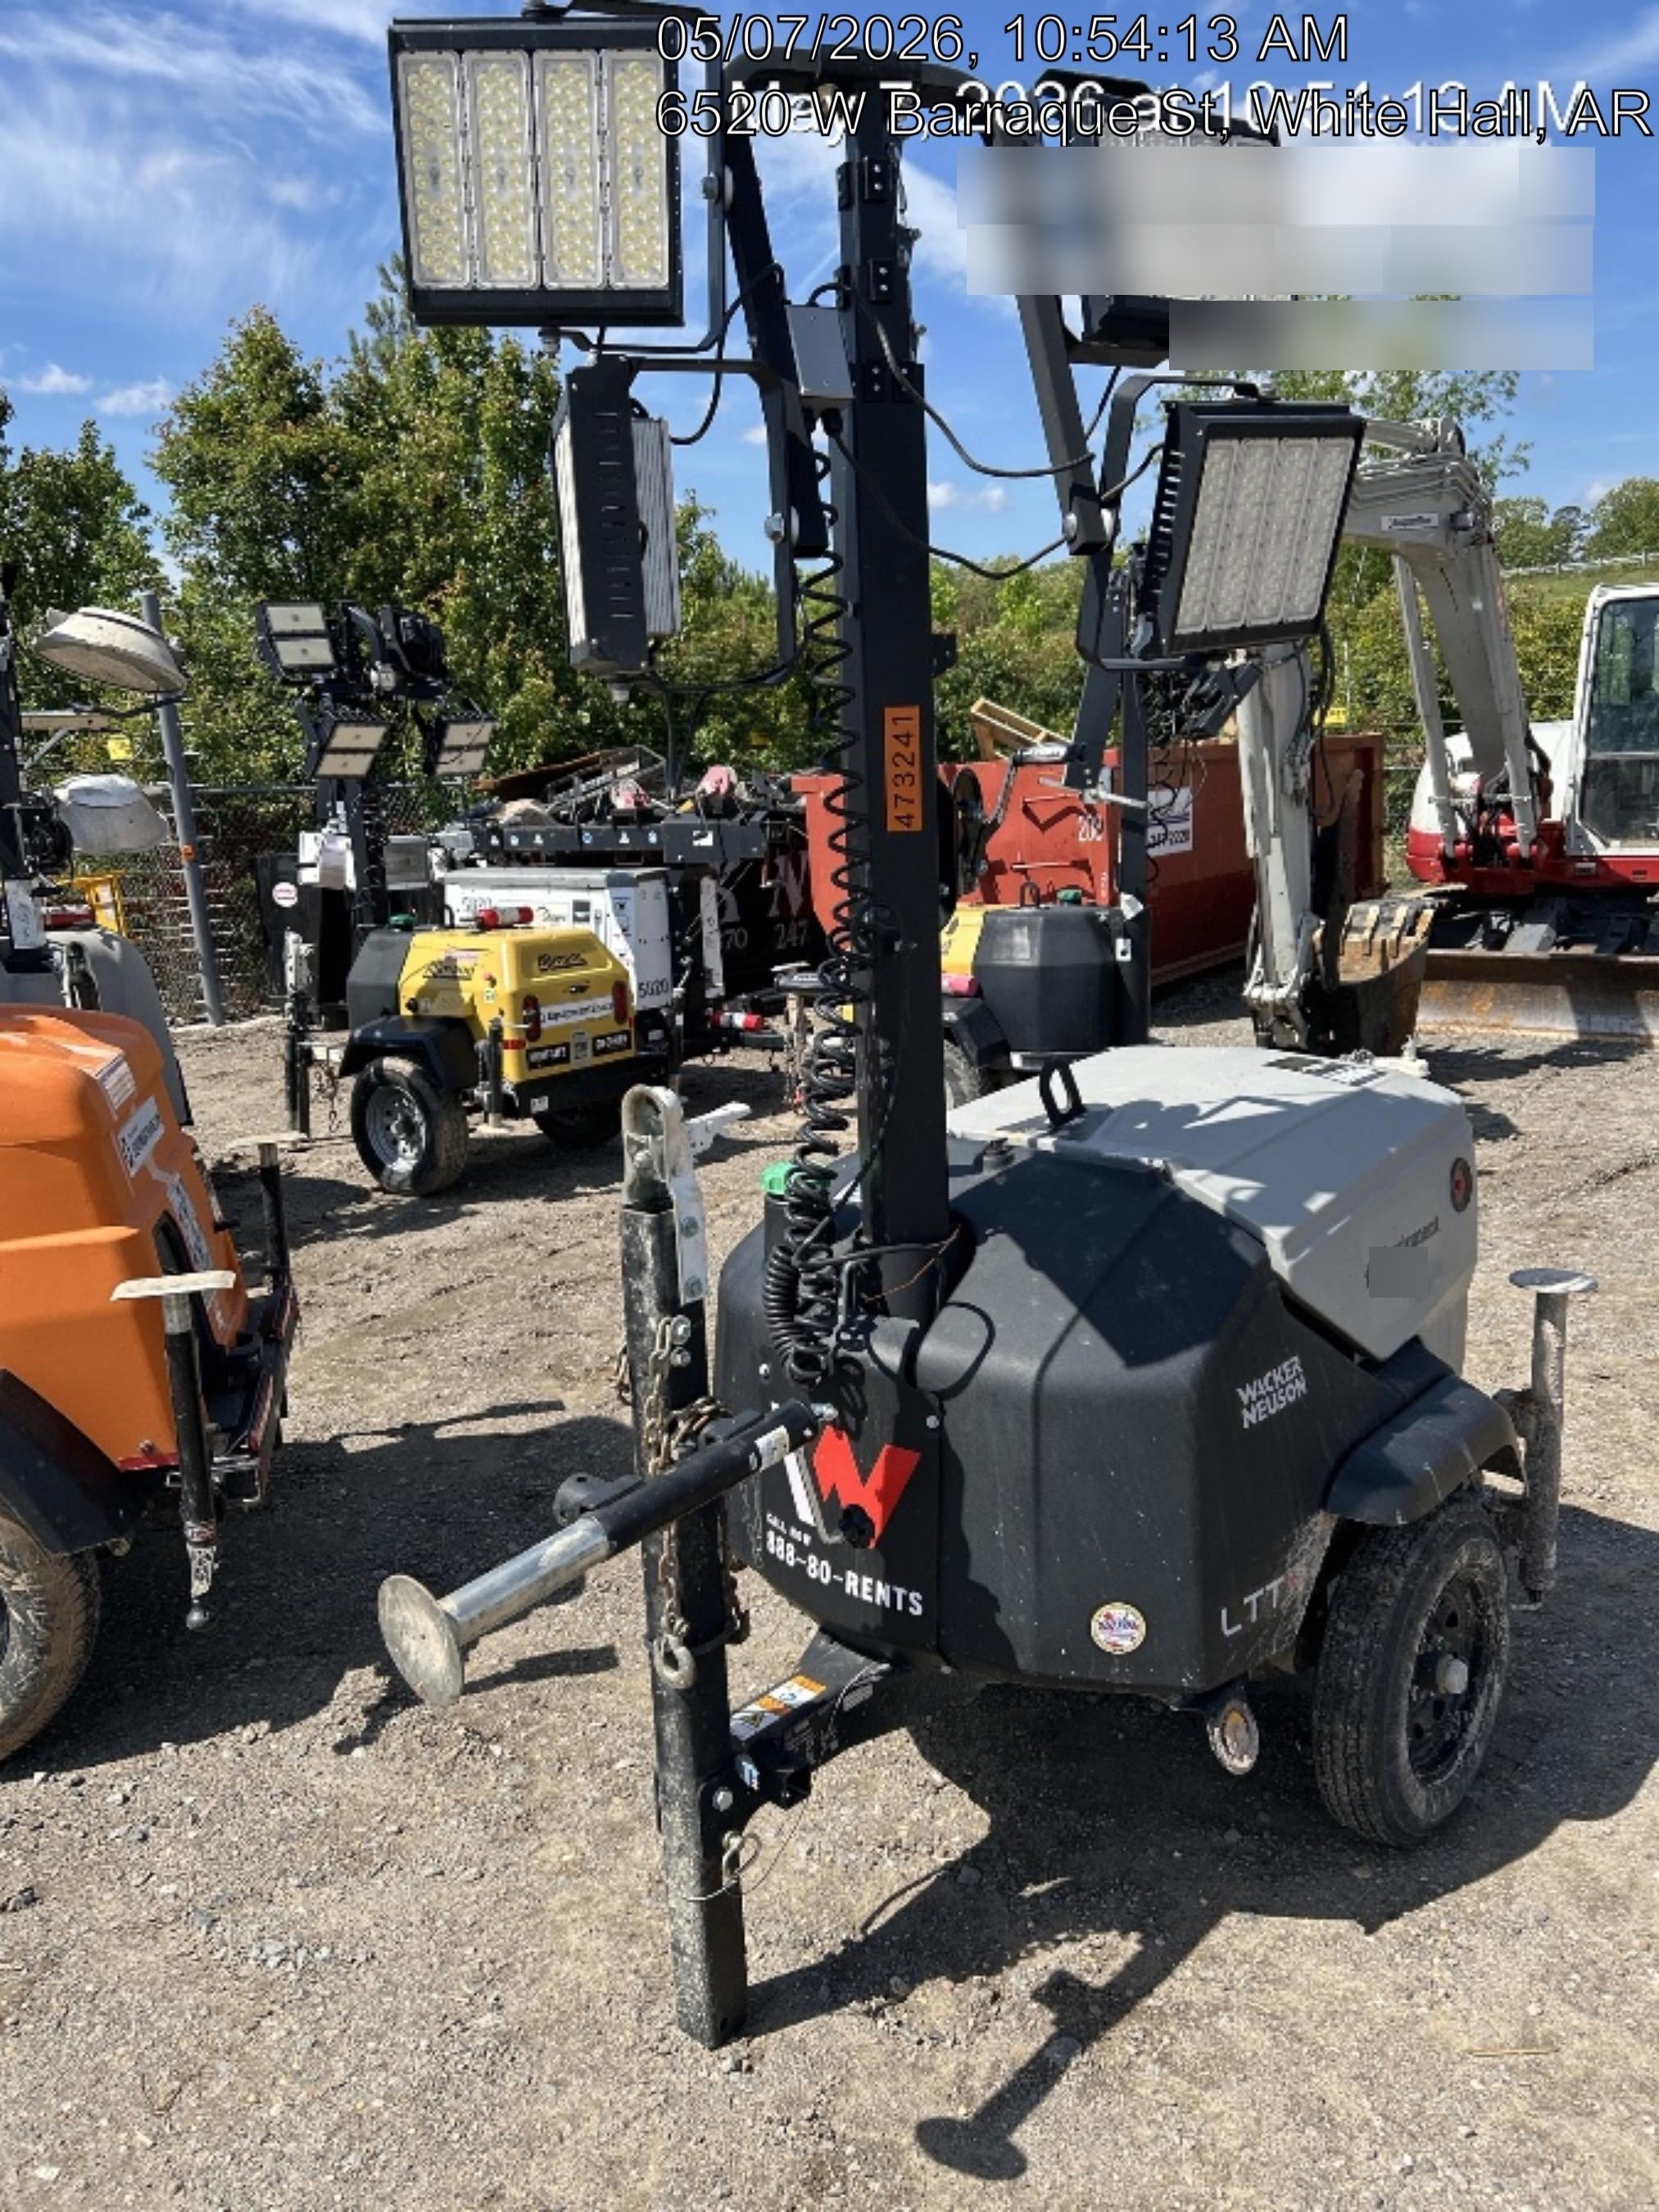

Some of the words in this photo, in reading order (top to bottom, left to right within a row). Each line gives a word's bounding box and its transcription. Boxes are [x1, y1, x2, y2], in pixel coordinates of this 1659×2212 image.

[891, 715, 916, 829] 473241
[1235, 1356, 1303, 1406] WACKER
[1241, 1373, 1308, 1429] NEUSON
[767, 1530, 923, 1616] 888-80-RENTS
